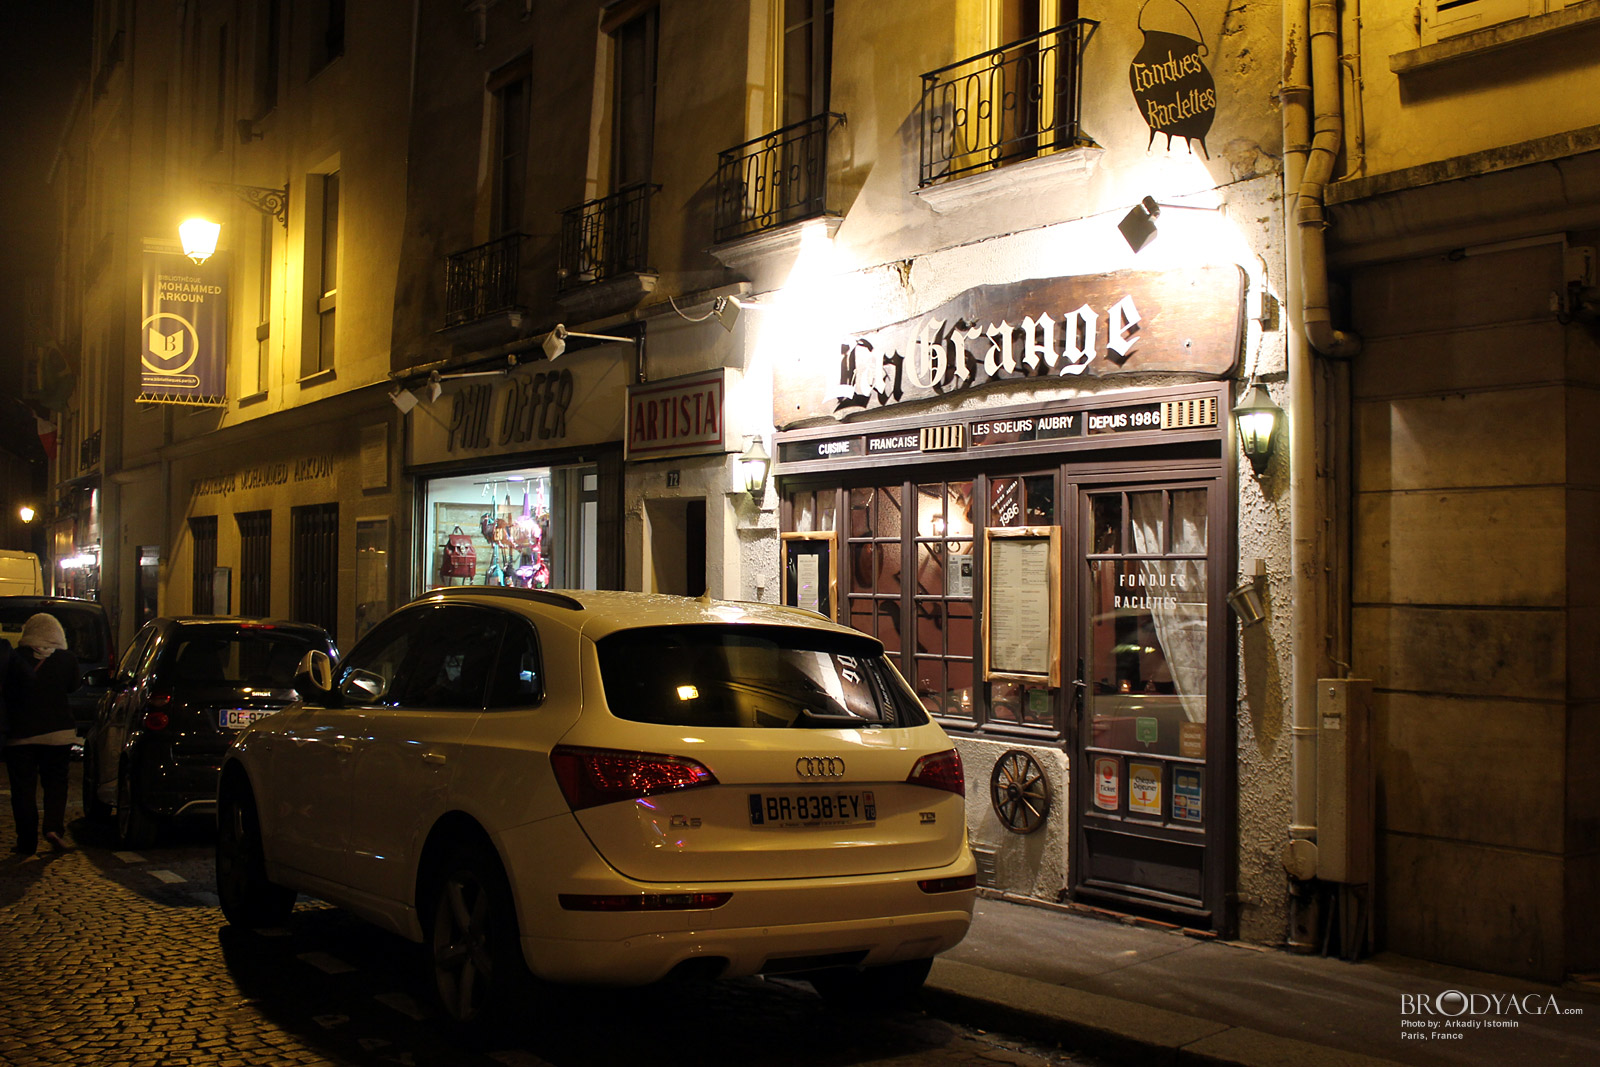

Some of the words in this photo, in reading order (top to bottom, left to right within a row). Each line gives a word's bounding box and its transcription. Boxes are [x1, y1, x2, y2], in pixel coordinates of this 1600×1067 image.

[1132, 50, 1202, 92] Fondues
[1146, 88, 1216, 129] Raclettes
[158, 282, 222, 295] MOHAMMED
[158, 292, 204, 303] ARKOUN
[905, 294, 1142, 389] Grange
[447, 383, 492, 452] PHIL
[498, 368, 573, 447] DEFER
[633, 390, 718, 443] ARTISTA
[1088, 413, 1128, 430] DEPUIS
[1129, 410, 1160, 427] 1986
[972, 423, 990, 436] LES
[993, 419, 1033, 434] SOEURS
[1038, 415, 1074, 431] AUBRY
[818, 441, 850, 456] CUISINE
[869, 435, 919, 451] FRANCAISE
[668, 473, 680, 486] 72
[999, 502, 1020, 527] 1986
[1119, 574, 1186, 588] FONDUES
[1114, 595, 1177, 610] RACLETTES
[766, 795, 859, 820] BR-838-EY
[865, 806, 876, 818] 78
